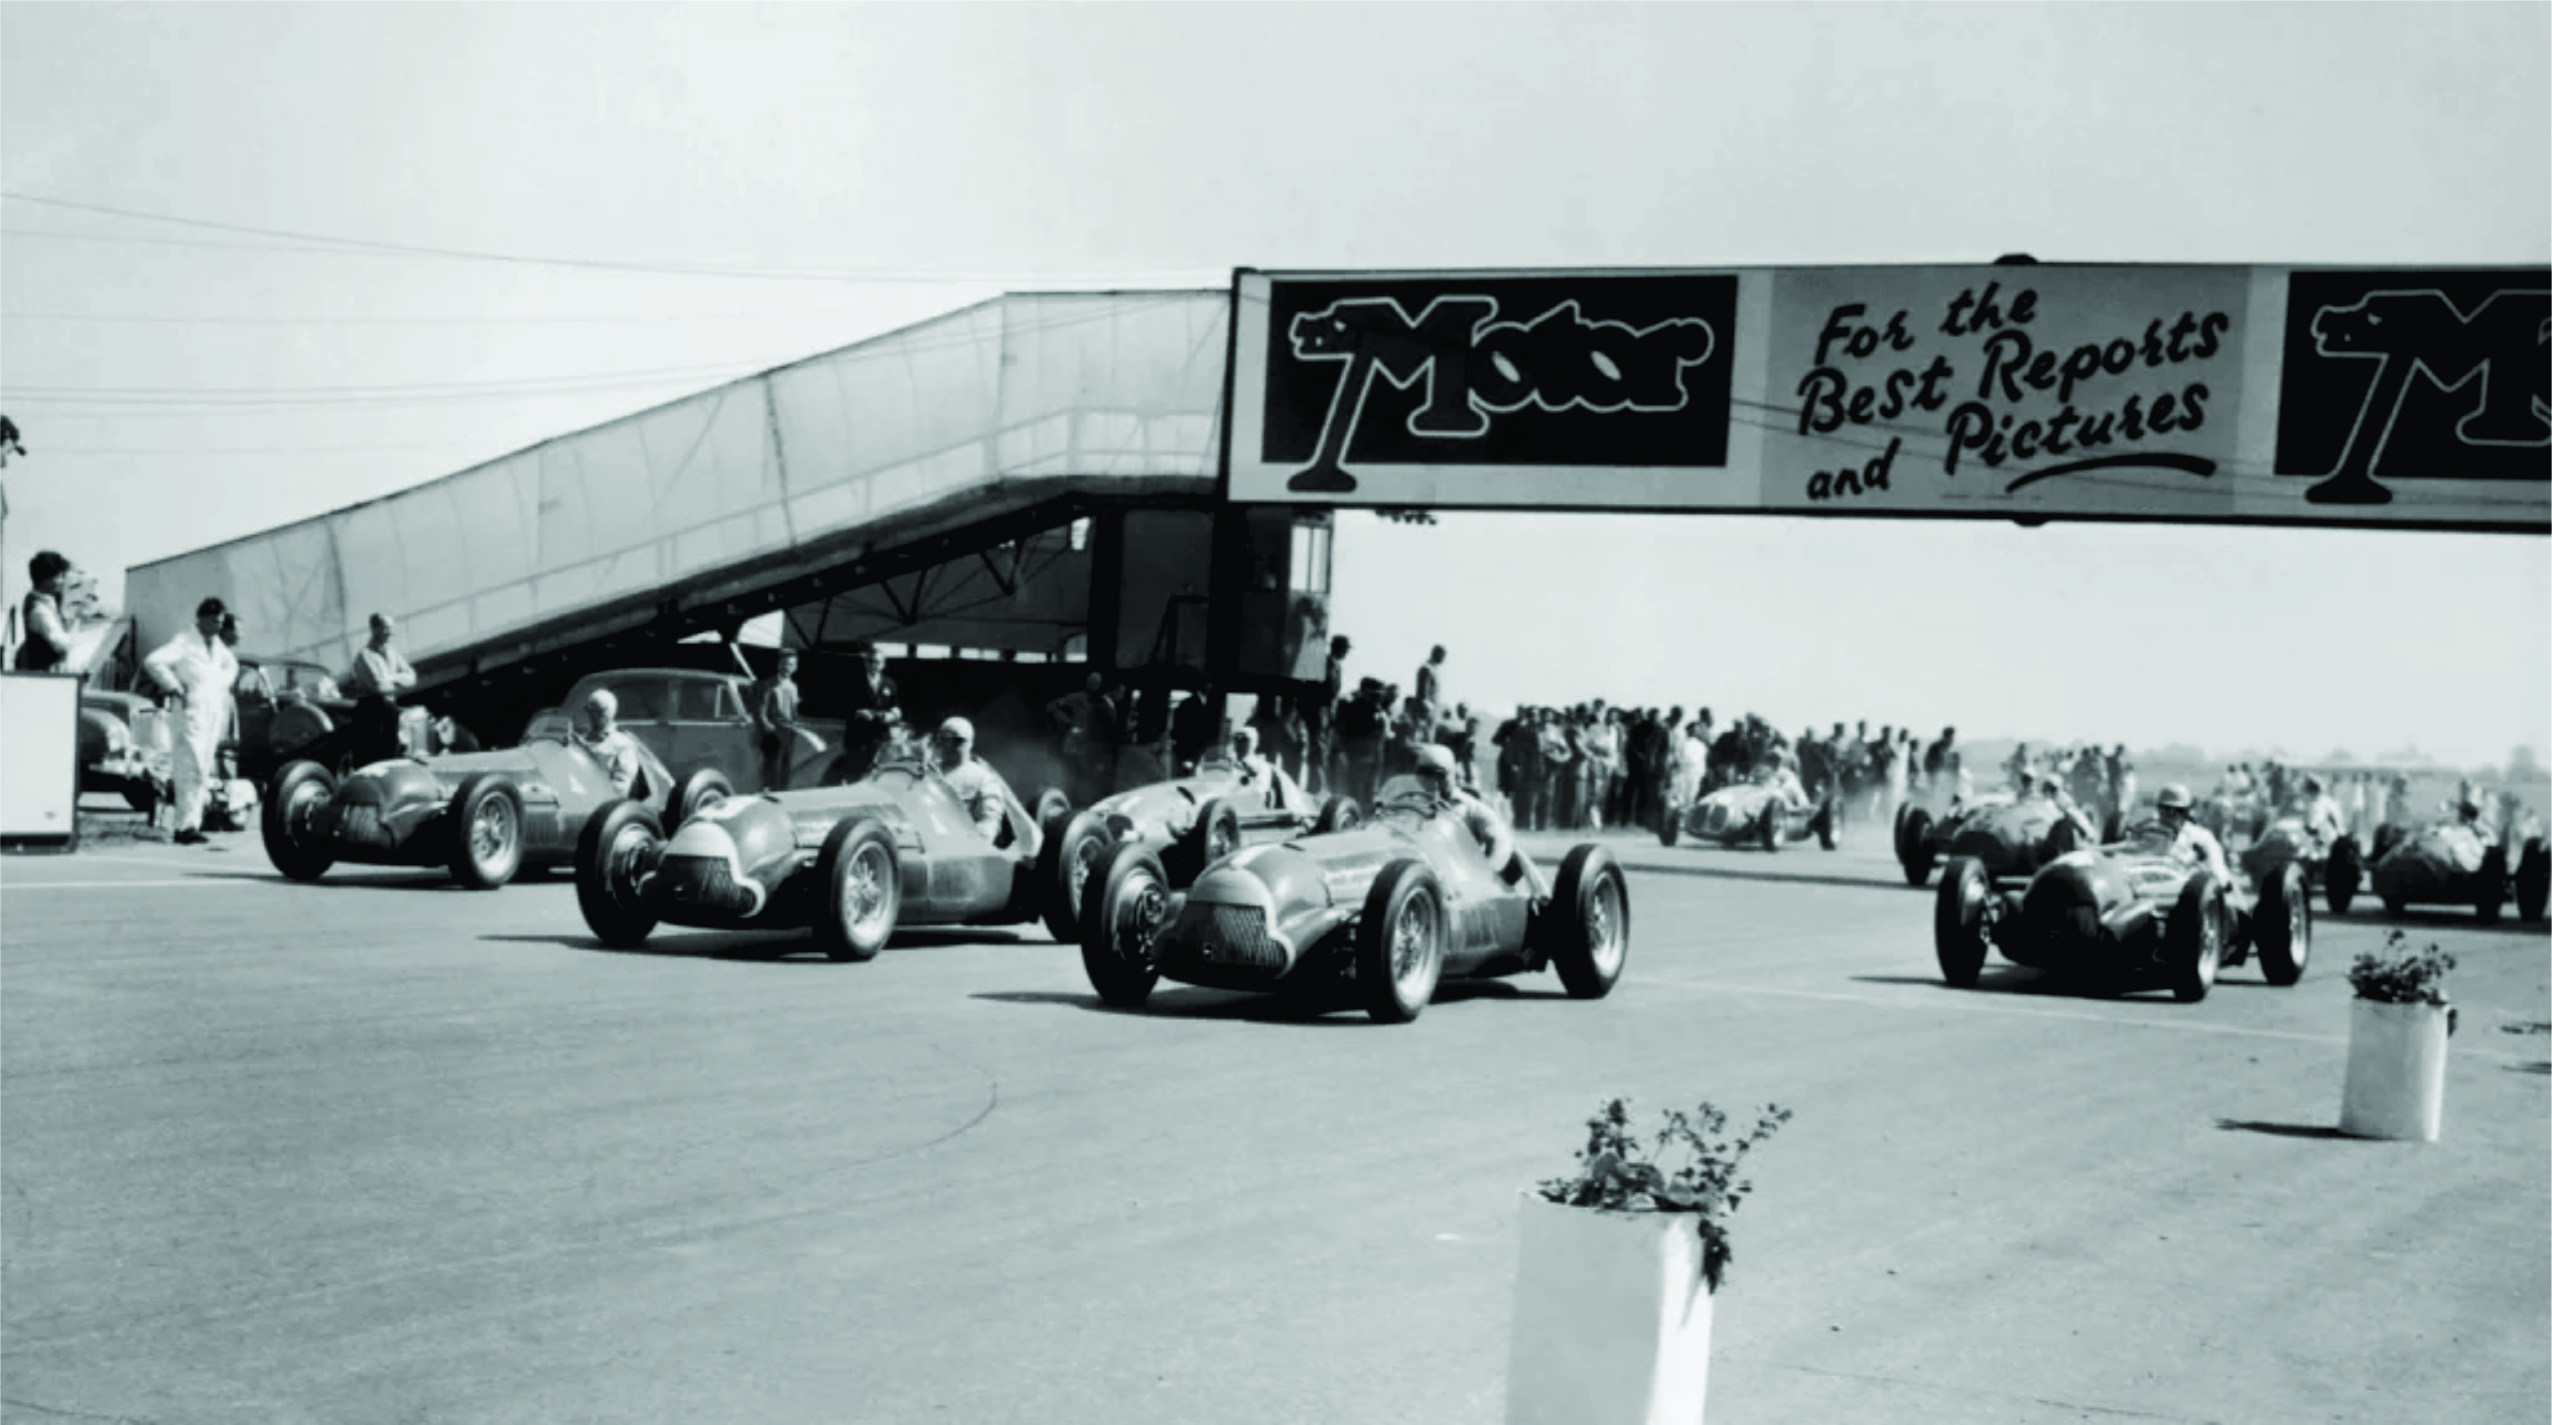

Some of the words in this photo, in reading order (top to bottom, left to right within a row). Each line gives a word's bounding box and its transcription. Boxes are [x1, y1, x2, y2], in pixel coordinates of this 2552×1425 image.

[1798, 356, 1955, 436] Best
[1978, 311, 2230, 404] Reports
[1814, 303, 1914, 367] For
[1939, 280, 2038, 336] the
[1287, 296, 1714, 493] Motor
[1807, 437, 1902, 500] and
[1944, 383, 2210, 476] Pictures
[2304, 287, 2552, 505] M
